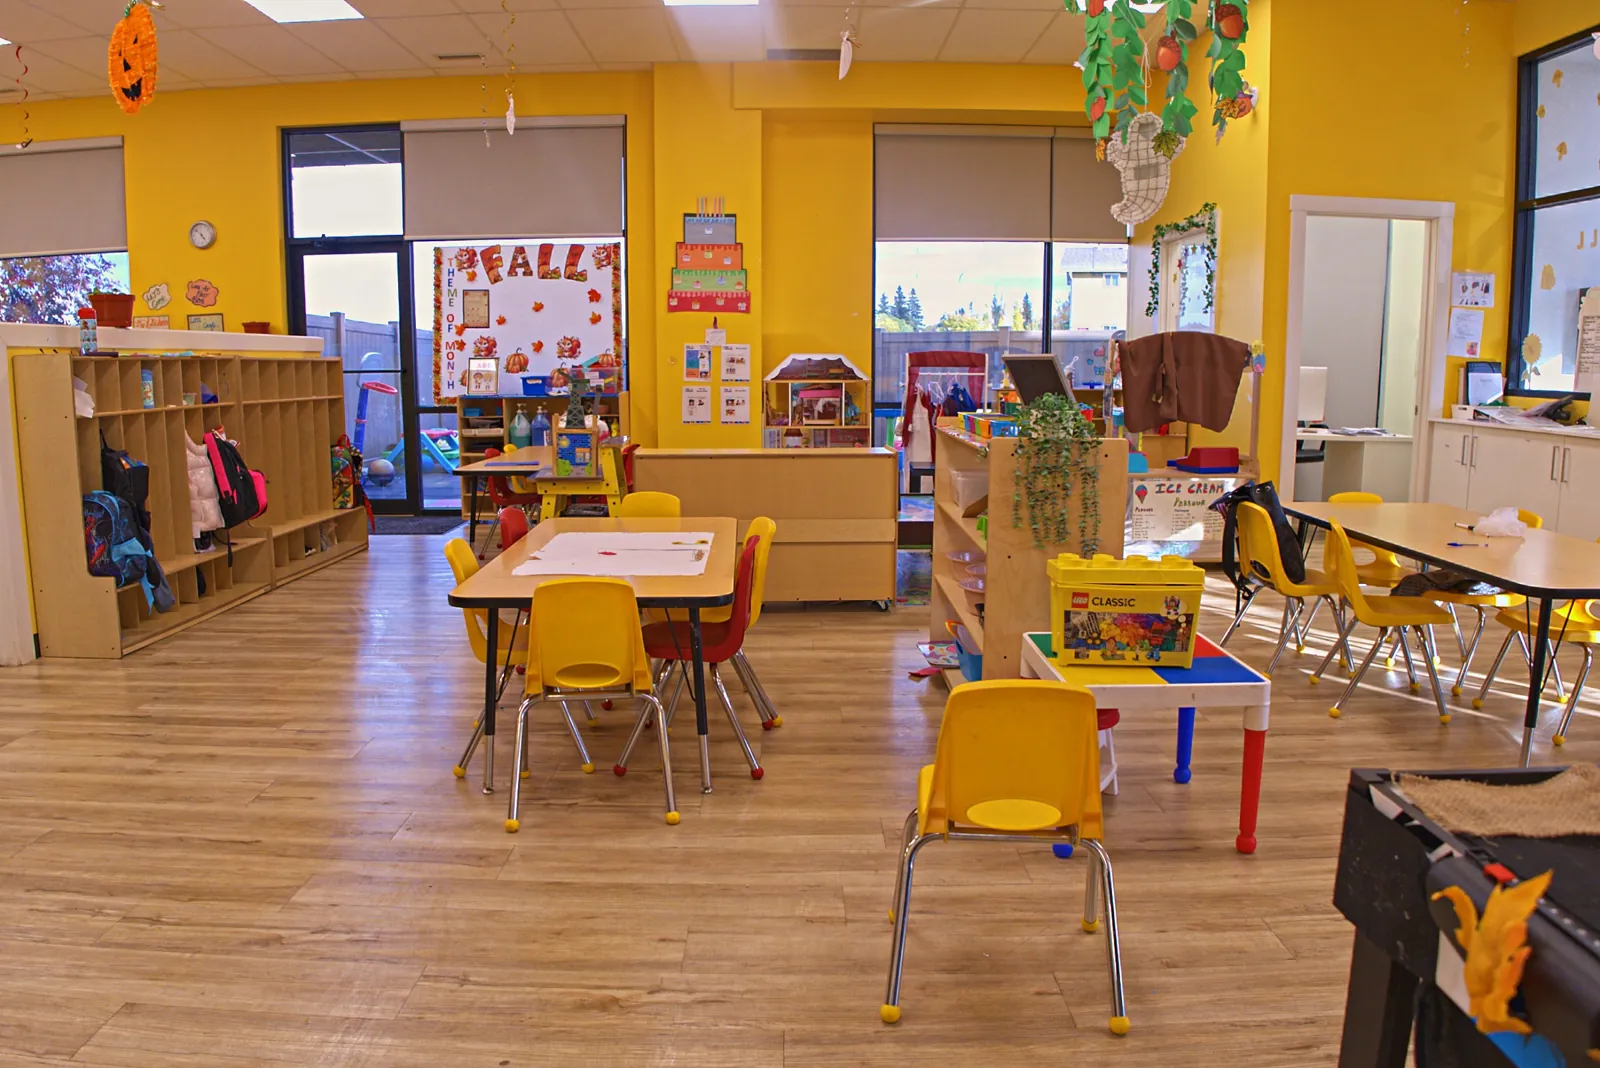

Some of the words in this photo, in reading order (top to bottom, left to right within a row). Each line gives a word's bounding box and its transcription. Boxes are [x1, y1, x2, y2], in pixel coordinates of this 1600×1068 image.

[480, 243, 587, 285] FALL
[446, 257, 458, 307] THEME
[446, 313, 455, 333] OF
[445, 341, 456, 390] MONTH
[1155, 483, 1182, 494] ICE
[1187, 483, 1224, 494] CREAM
[1073, 597, 1088, 605] LEGO
[1091, 596, 1136, 607] CLASSIC
